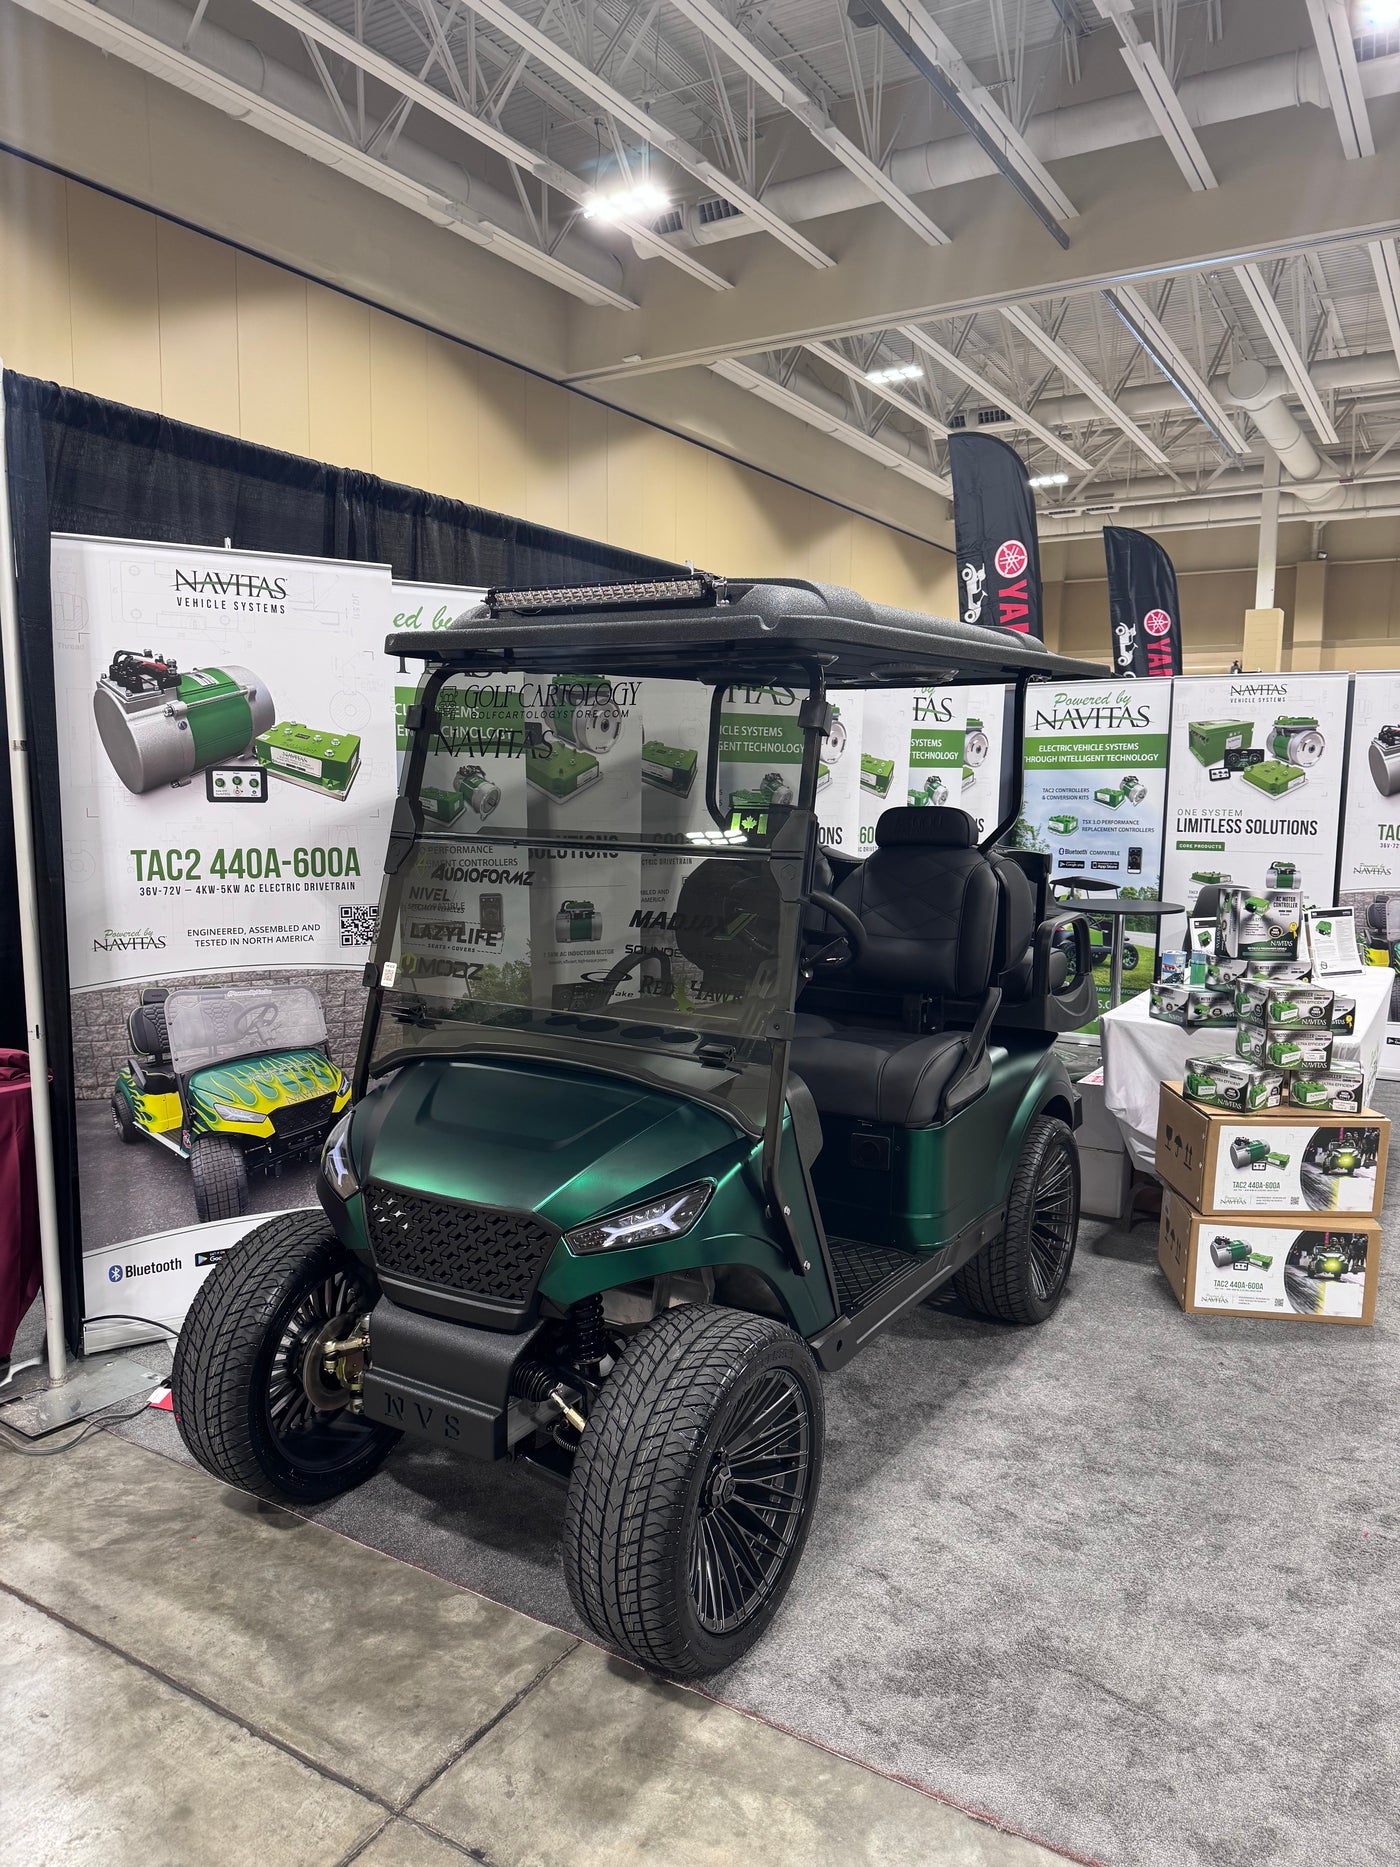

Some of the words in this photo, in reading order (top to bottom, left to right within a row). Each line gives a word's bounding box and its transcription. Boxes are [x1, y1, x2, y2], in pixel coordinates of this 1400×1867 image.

[174, 568, 288, 600] NAVITAS
[176, 596, 227, 610] VEHICLE
[233, 601, 286, 614] SYSTEMS
[464, 684, 516, 708] GOLF
[518, 681, 642, 708] CARTOLOGY
[1230, 683, 1288, 696] NAVITAS
[1054, 692, 1112, 707] Powered
[1115, 690, 1132, 706] by
[1033, 705, 1151, 731] NAVITAS
[741, 726, 783, 737] SYSTEMS
[434, 729, 554, 759] NAVITAS
[911, 738, 942, 747] SYSTEMS
[1038, 744, 1072, 752] ELECTRIC
[1073, 744, 1104, 752] VEHICLE
[1104, 742, 1139, 751] SYSTEMS
[912, 751, 959, 760] TECHNOLOGY
[1058, 754, 1106, 763] INTELLIGENT
[1106, 753, 1159, 761] TECHNOLOGY
[1177, 808, 1198, 816] ONE
[1201, 809, 1243, 817] SYSTEM
[1176, 818, 1242, 834] LIMITLESS
[1245, 819, 1318, 836] SOLUTIONS
[818, 826, 843, 845] ONS
[130, 849, 201, 882] TAC2
[209, 847, 361, 879] 440A-600A
[458, 858, 518, 868] CONTROLLERS
[139, 886, 181, 897] 36V-72V
[195, 884, 240, 895] 4KW-5KW
[244, 883, 255, 893] AC
[259, 882, 300, 893] ELECTRIC
[304, 881, 356, 891] DRIVETRAIN
[408, 886, 450, 902] NIVEL
[104, 928, 142, 939] Powered
[143, 927, 153, 938] by
[187, 926, 247, 937] ENGINEERED,
[249, 924, 300, 934] ASSEMBLED
[302, 923, 321, 932] AND
[93, 936, 166, 952] NAVITAS
[195, 938, 228, 948] TESTED
[230, 937, 239, 946] IN
[241, 936, 274, 945] NORTH
[275, 934, 314, 944] AMERICA
[451, 945, 475, 953] COVERS
[1217, 1098, 1242, 1109] NAVITAS
[1232, 1181, 1247, 1189] TAC2
[125, 1258, 182, 1279] Bluetooth
[1214, 1279, 1229, 1288] TAC2
[1229, 1281, 1264, 1290] 440A-600A
[384, 1392, 460, 1441] NVS
